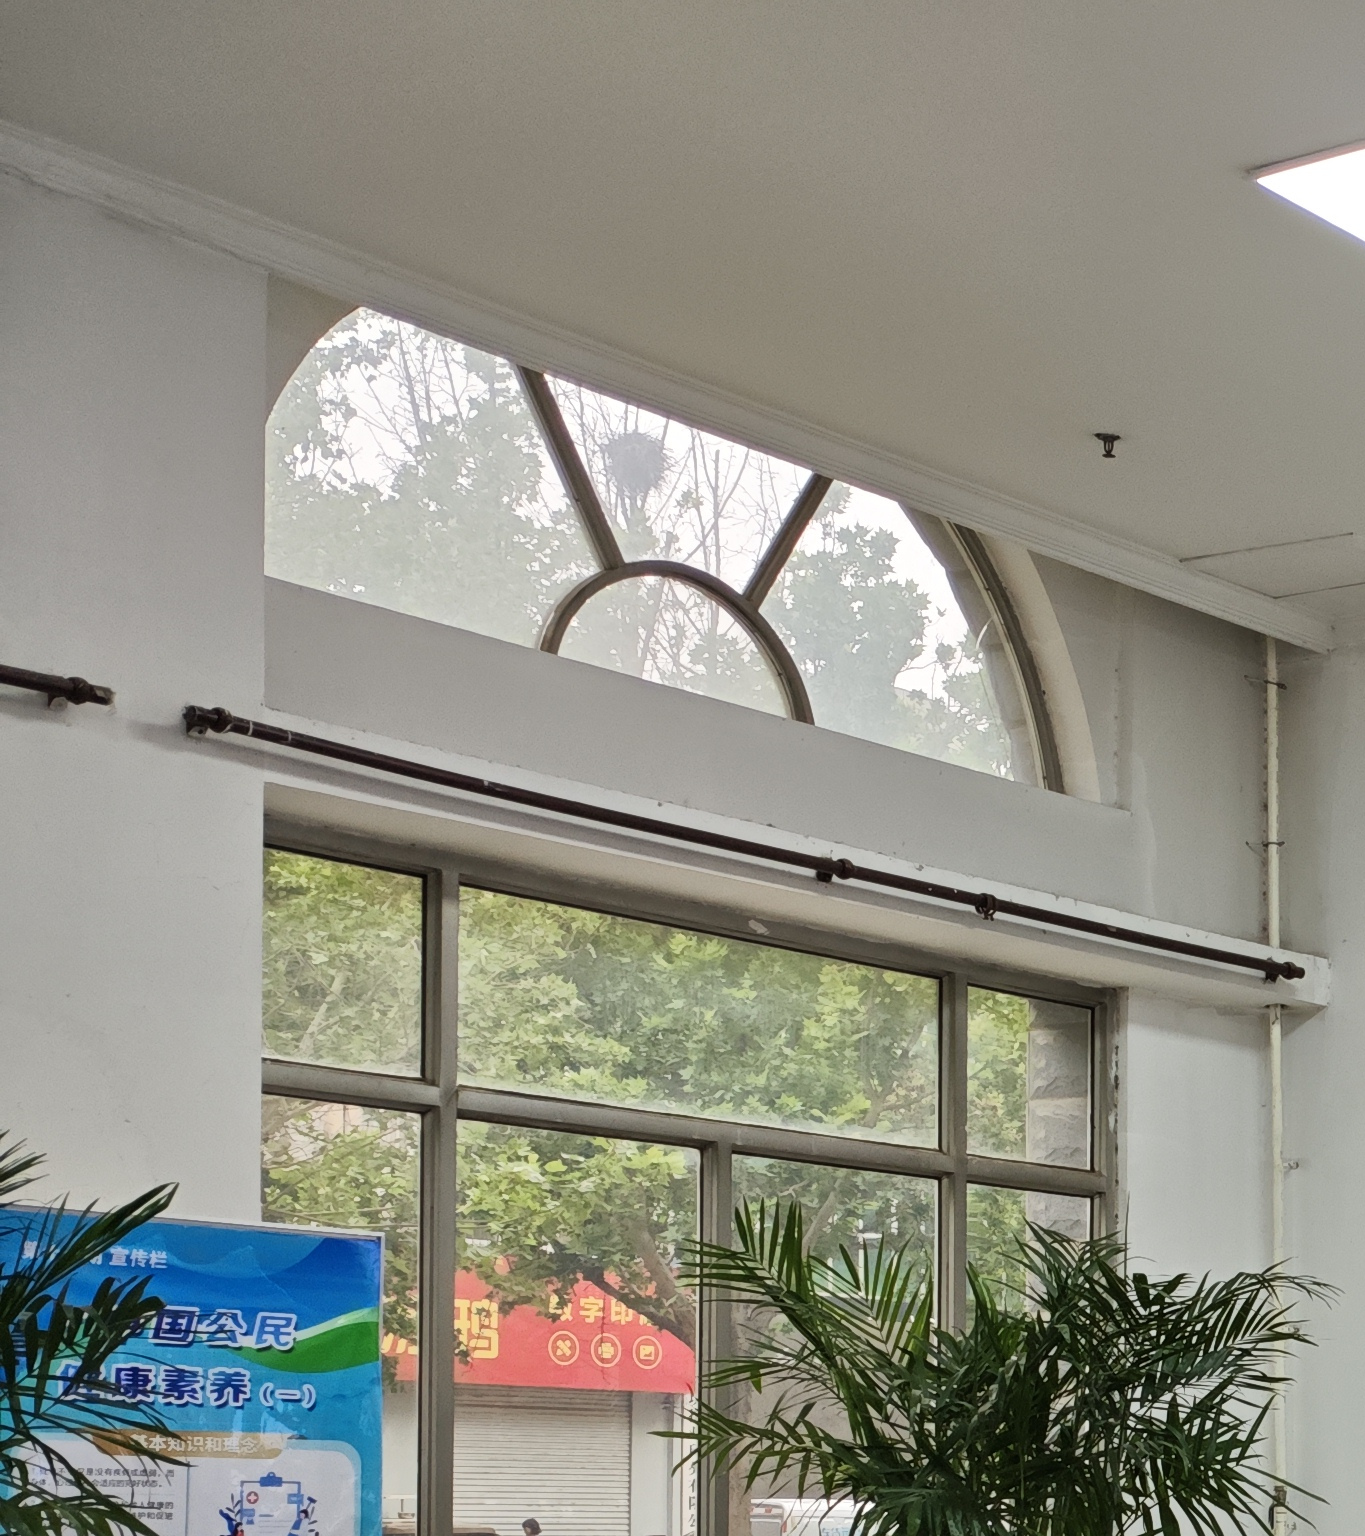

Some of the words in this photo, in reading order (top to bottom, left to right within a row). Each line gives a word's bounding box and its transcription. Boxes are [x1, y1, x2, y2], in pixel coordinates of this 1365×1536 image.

[131, 1433, 259, 1454] 基本知识和理念
